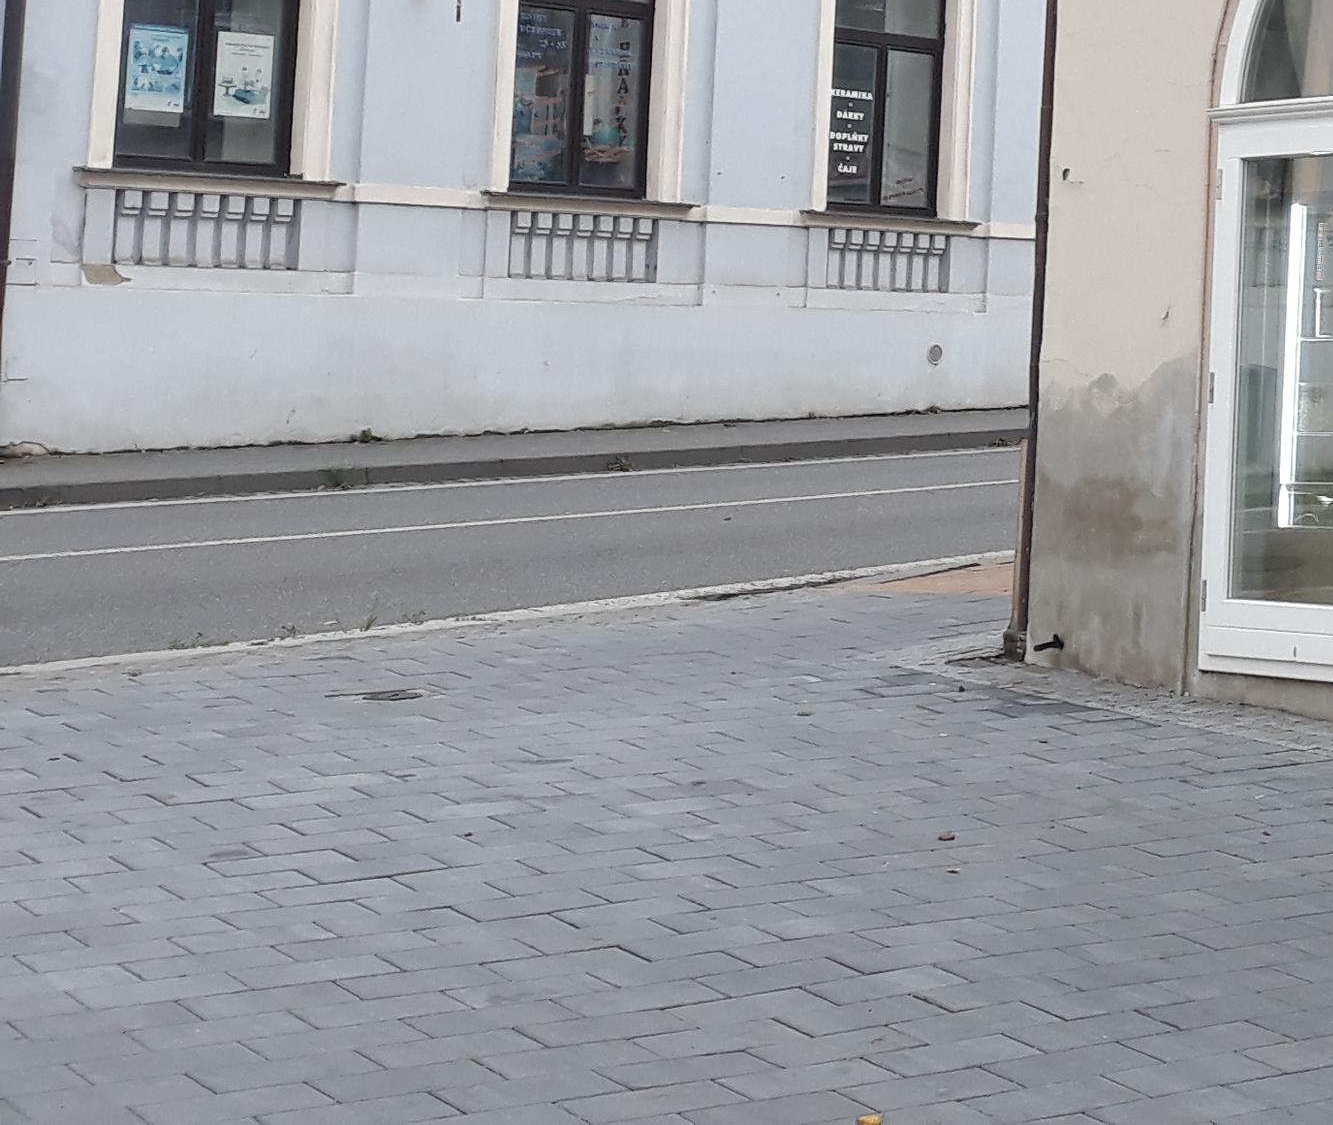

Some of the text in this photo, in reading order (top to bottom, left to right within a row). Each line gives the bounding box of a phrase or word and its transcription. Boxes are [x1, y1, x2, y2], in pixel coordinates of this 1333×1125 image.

[831, 89, 873, 100] KERAMIKA
[833, 143, 864, 152] STRAVY
[838, 163, 857, 173] ČAJE
